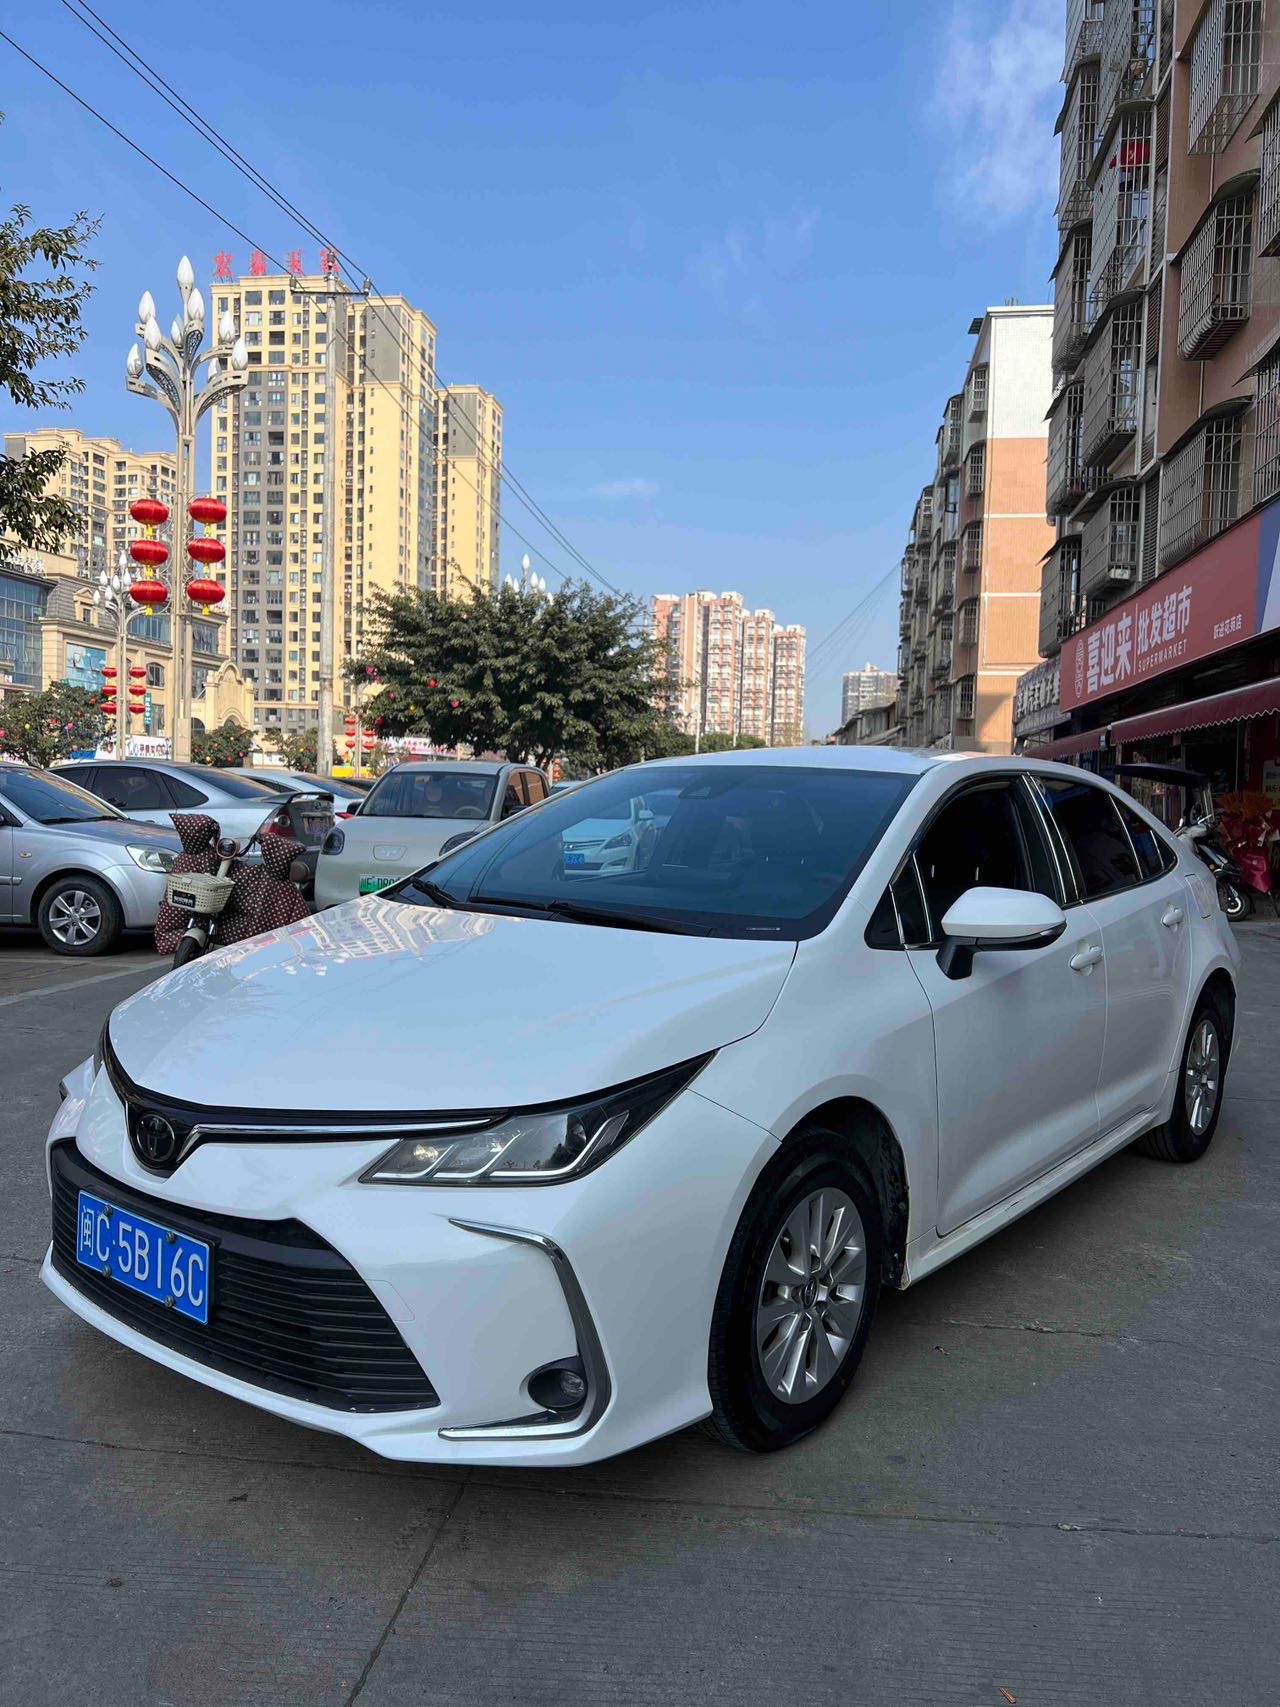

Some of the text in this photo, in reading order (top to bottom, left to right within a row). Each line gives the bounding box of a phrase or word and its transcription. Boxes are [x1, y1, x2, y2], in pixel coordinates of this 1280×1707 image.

[1087, 584, 1193, 694] 喜迎来 批发超市
[1138, 639, 1188, 673] SUPERMARKET
